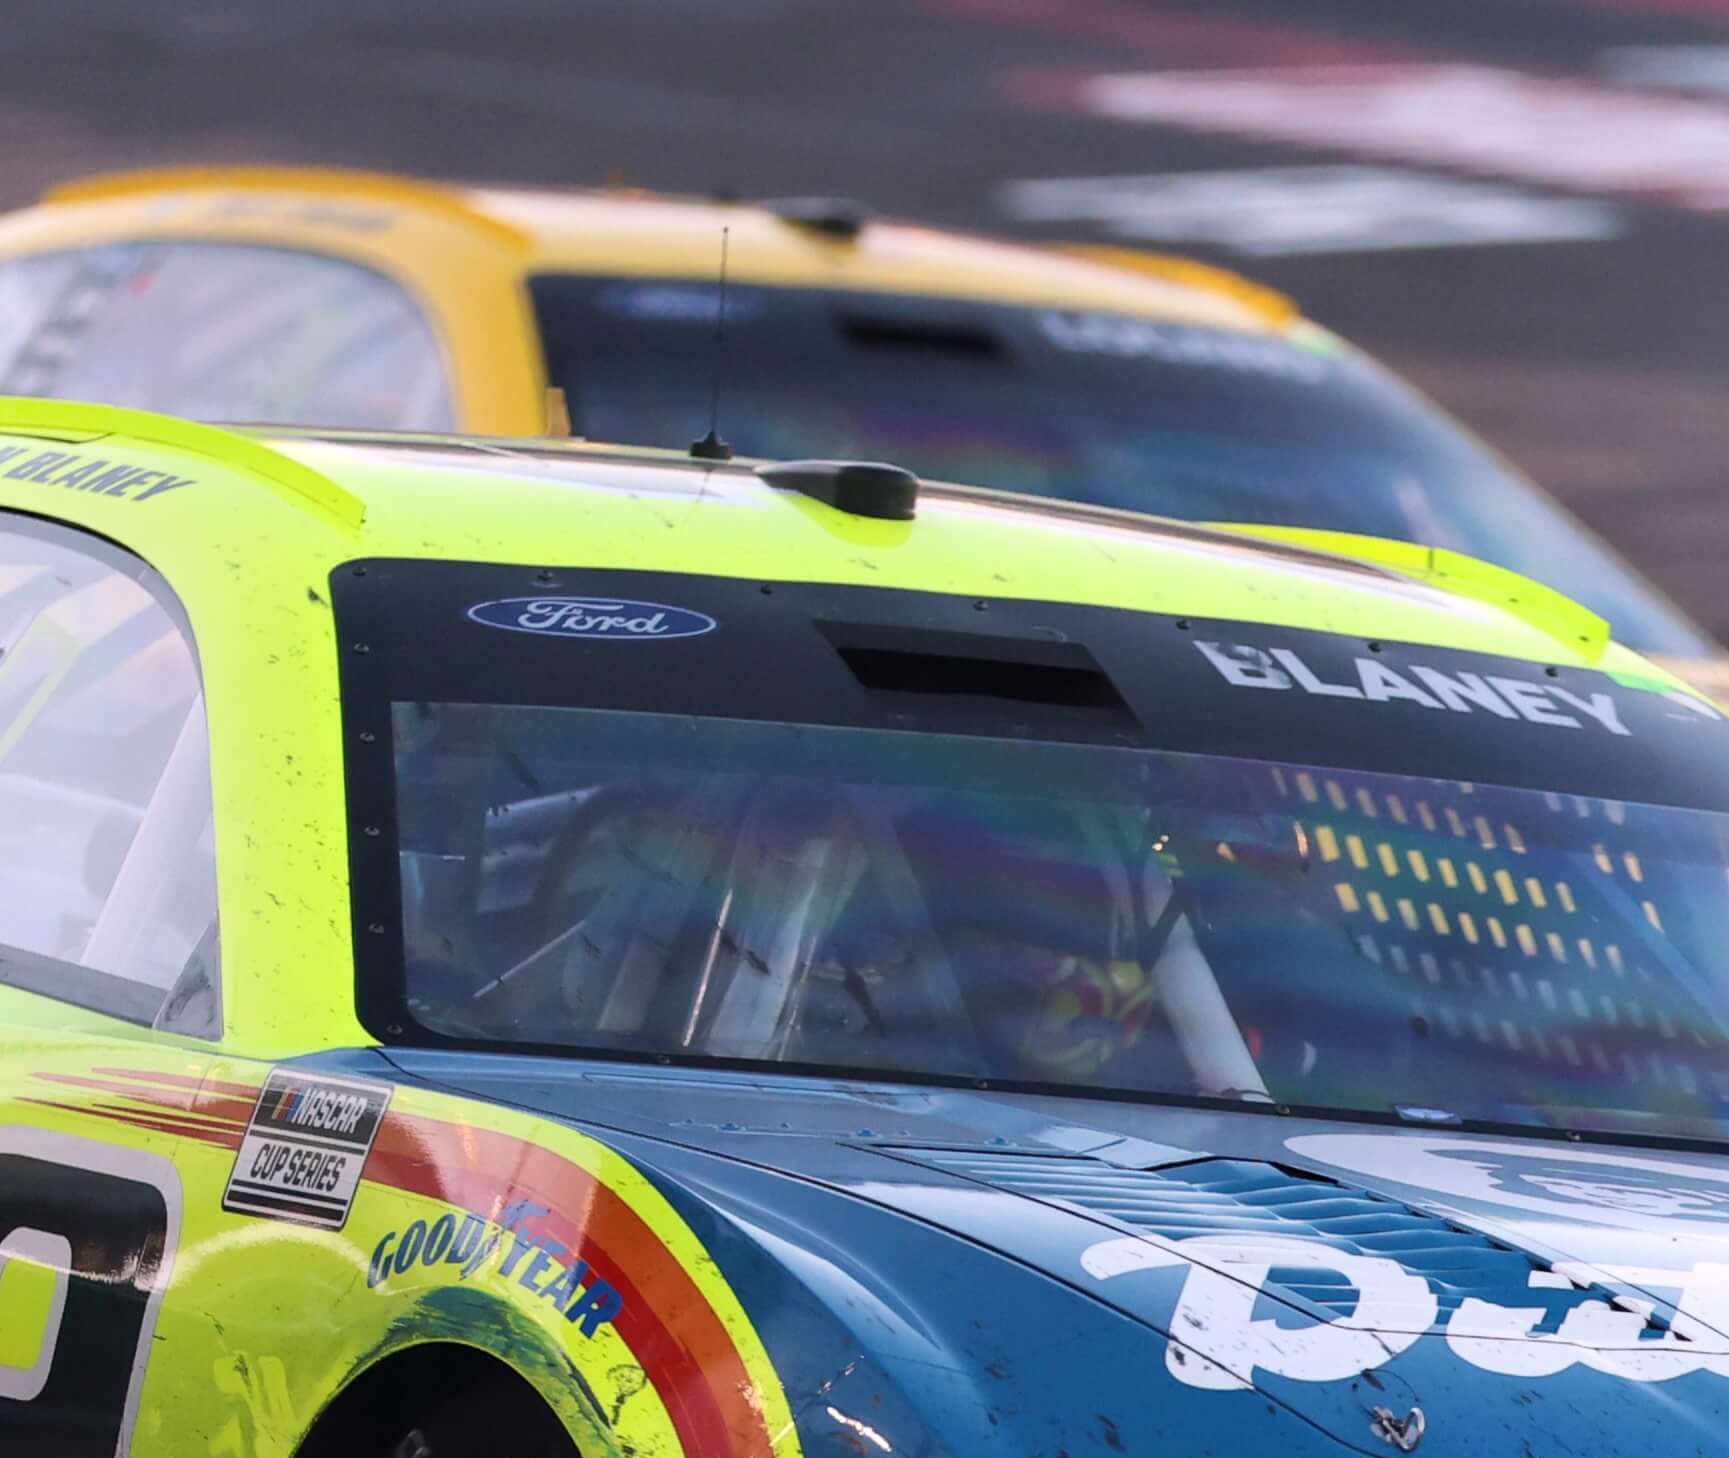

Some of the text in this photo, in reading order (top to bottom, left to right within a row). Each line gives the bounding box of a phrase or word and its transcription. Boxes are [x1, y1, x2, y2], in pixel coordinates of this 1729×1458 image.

[2, 451, 197, 502] BLANEY
[518, 600, 669, 634] Ford
[1192, 640, 1632, 737] BLANEY
[293, 1086, 370, 1134] NASCAR
[249, 1142, 347, 1193] CUP SERIES
[367, 1213, 624, 1340] GOODYEAR
